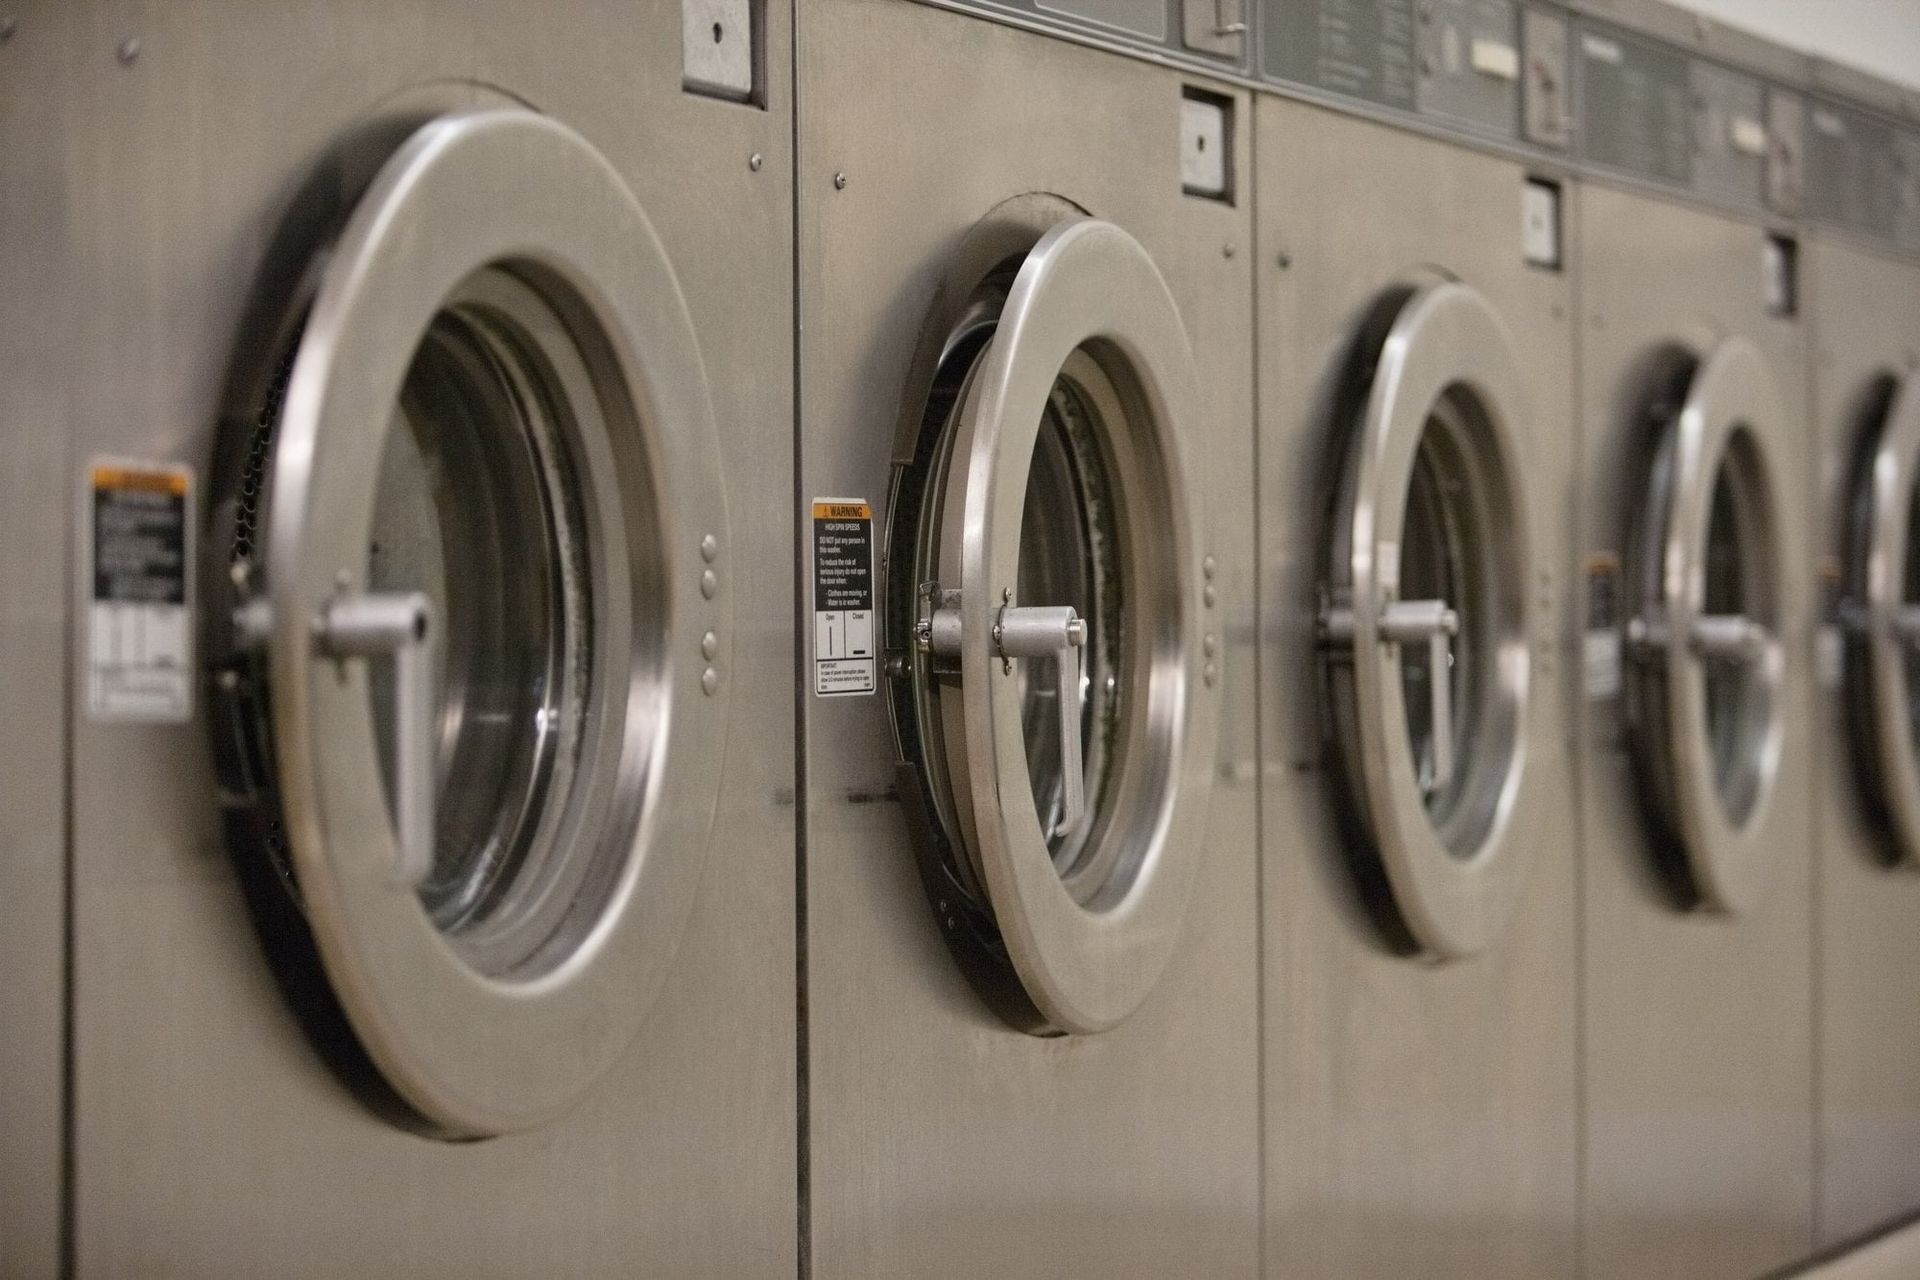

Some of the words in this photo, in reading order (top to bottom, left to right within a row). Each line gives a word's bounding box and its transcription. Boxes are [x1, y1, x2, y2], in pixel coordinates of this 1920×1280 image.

[830, 505, 863, 517] WARNING
[825, 523, 835, 531] HIGH
[835, 523, 844, 531] SPIN
[819, 536, 826, 544] DO
[826, 536, 834, 544] NOT
[861, 536, 865, 544] in
[820, 558, 825, 566] To
[852, 558, 856, 566] of
[834, 568, 844, 577] injury
[857, 568, 866, 576] open
[827, 577, 835, 585] door
[828, 589, 842, 597] Clothes
[825, 613, 835, 622] Open
[852, 612, 864, 620] Closed
